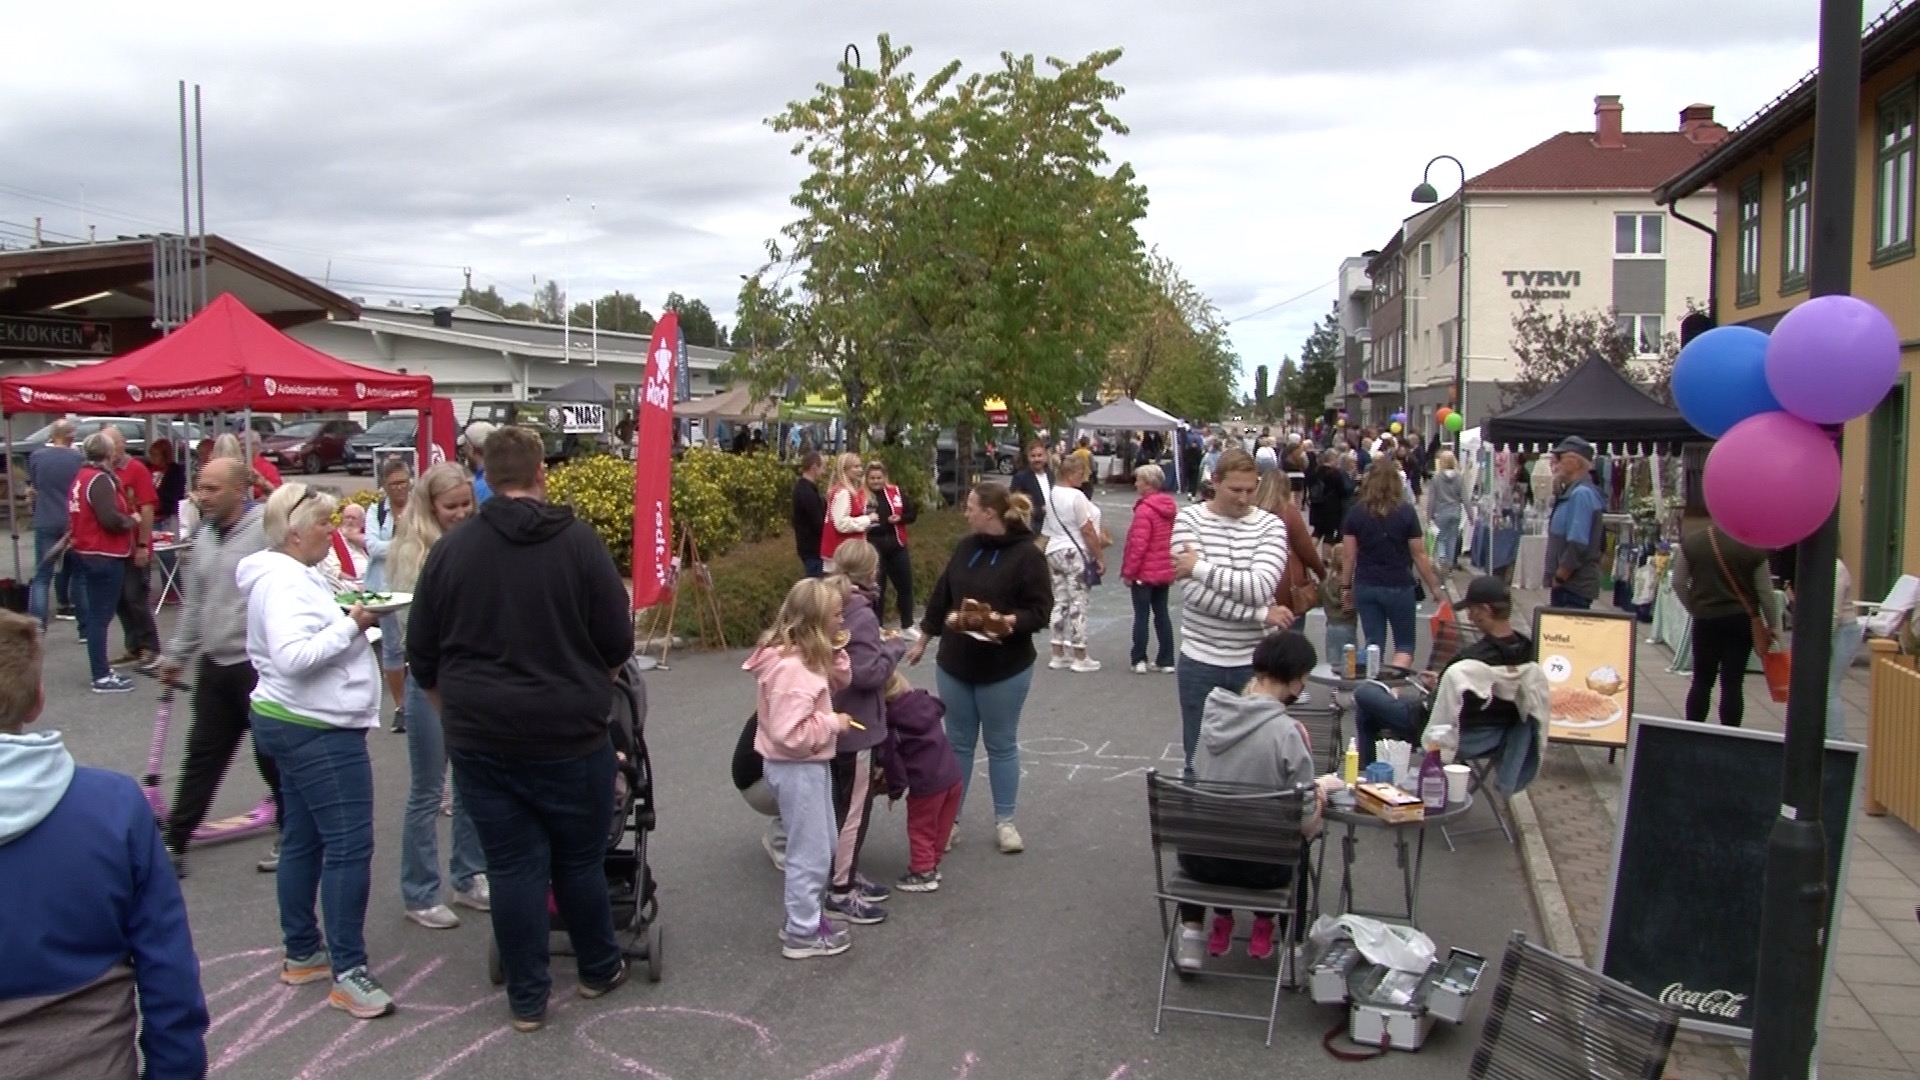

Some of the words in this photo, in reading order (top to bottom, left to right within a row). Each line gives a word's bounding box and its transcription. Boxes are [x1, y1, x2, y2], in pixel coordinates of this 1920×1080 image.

[1502, 270, 1581, 287] TYRVI
[1511, 287, 1570, 301] GÅRDEN
[1543, 633, 1571, 643] Vaffel
[1551, 663, 1564, 673] 79
[1659, 982, 1749, 1018] Coca-Cola
